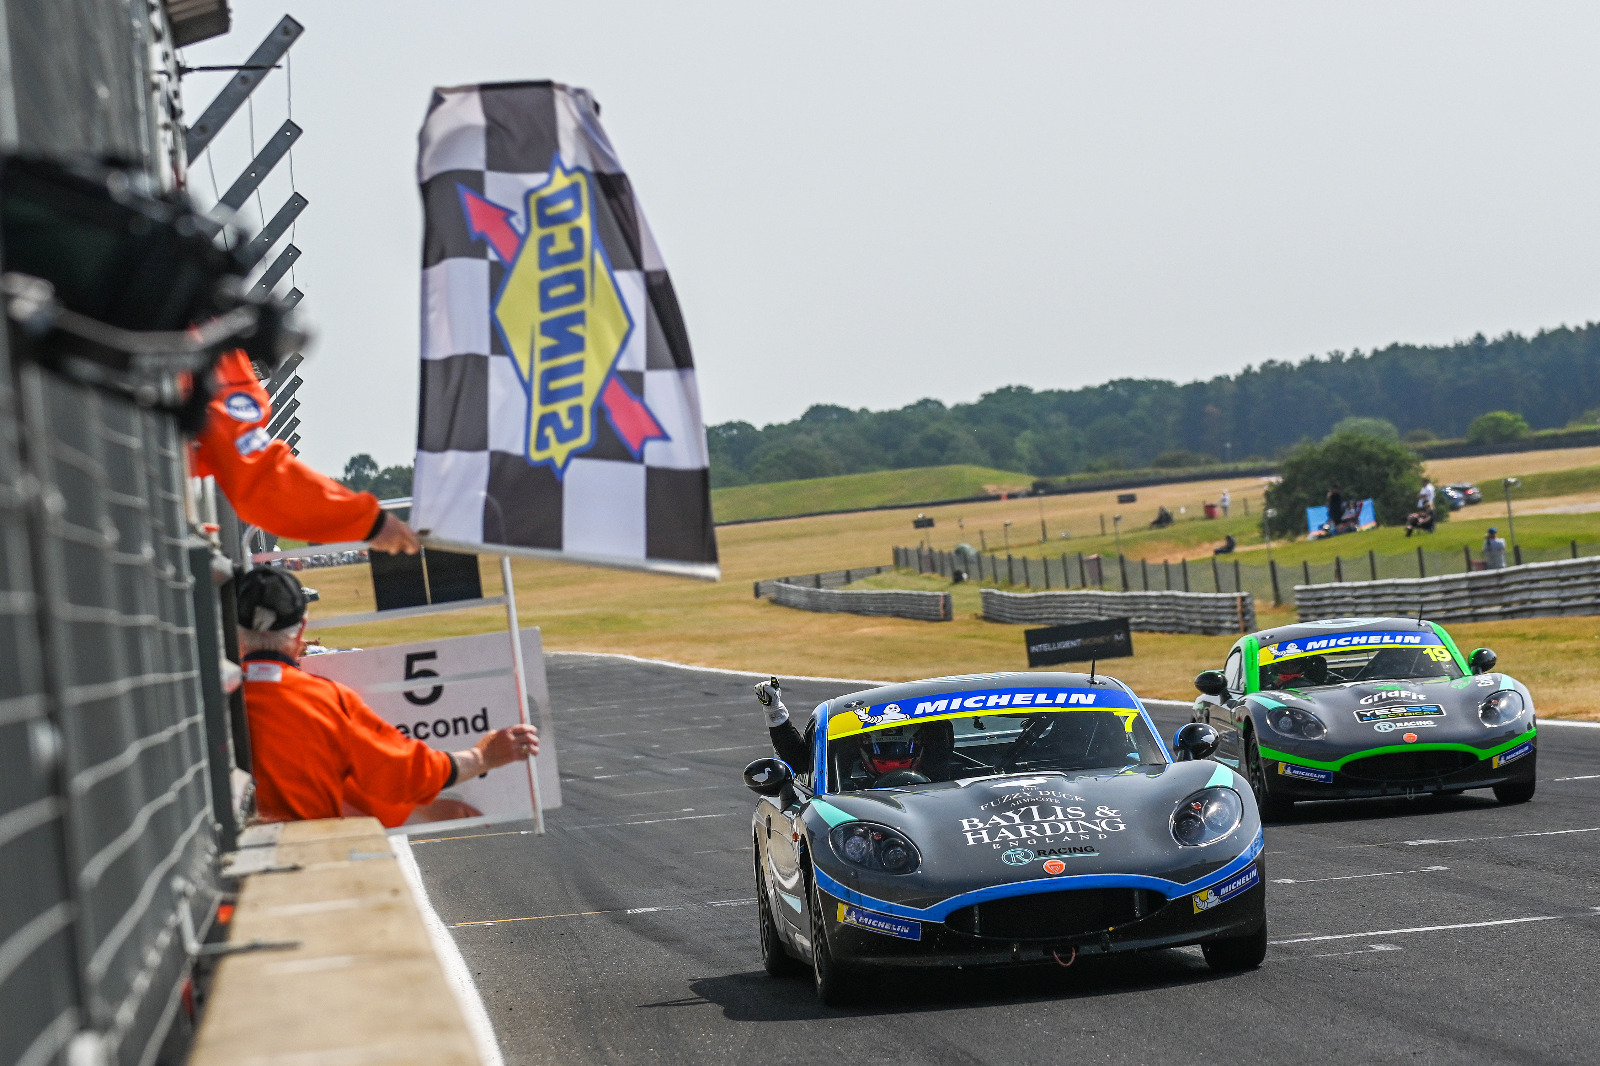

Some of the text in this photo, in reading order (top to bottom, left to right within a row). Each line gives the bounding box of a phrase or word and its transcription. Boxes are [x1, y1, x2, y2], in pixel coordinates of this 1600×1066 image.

[1306, 635, 1421, 650] MICHELIN
[1422, 648, 1452, 662] 19
[403, 650, 444, 707] 5
[914, 693, 1096, 715] MICHELIN
[1360, 705, 1438, 717] YESSS
[395, 707, 490, 740] econd
[1292, 770, 1326, 779] MICHELIN
[979, 790, 1086, 811] FUZZY DUCK
[958, 805, 1122, 832] BAYLIS &
[963, 818, 1127, 846] HARDING
[993, 833, 1108, 849] ENGLAND
[1036, 845, 1096, 857] RACING
[1220, 868, 1257, 896] MICHELIN
[858, 916, 910, 933] MICHELIN
